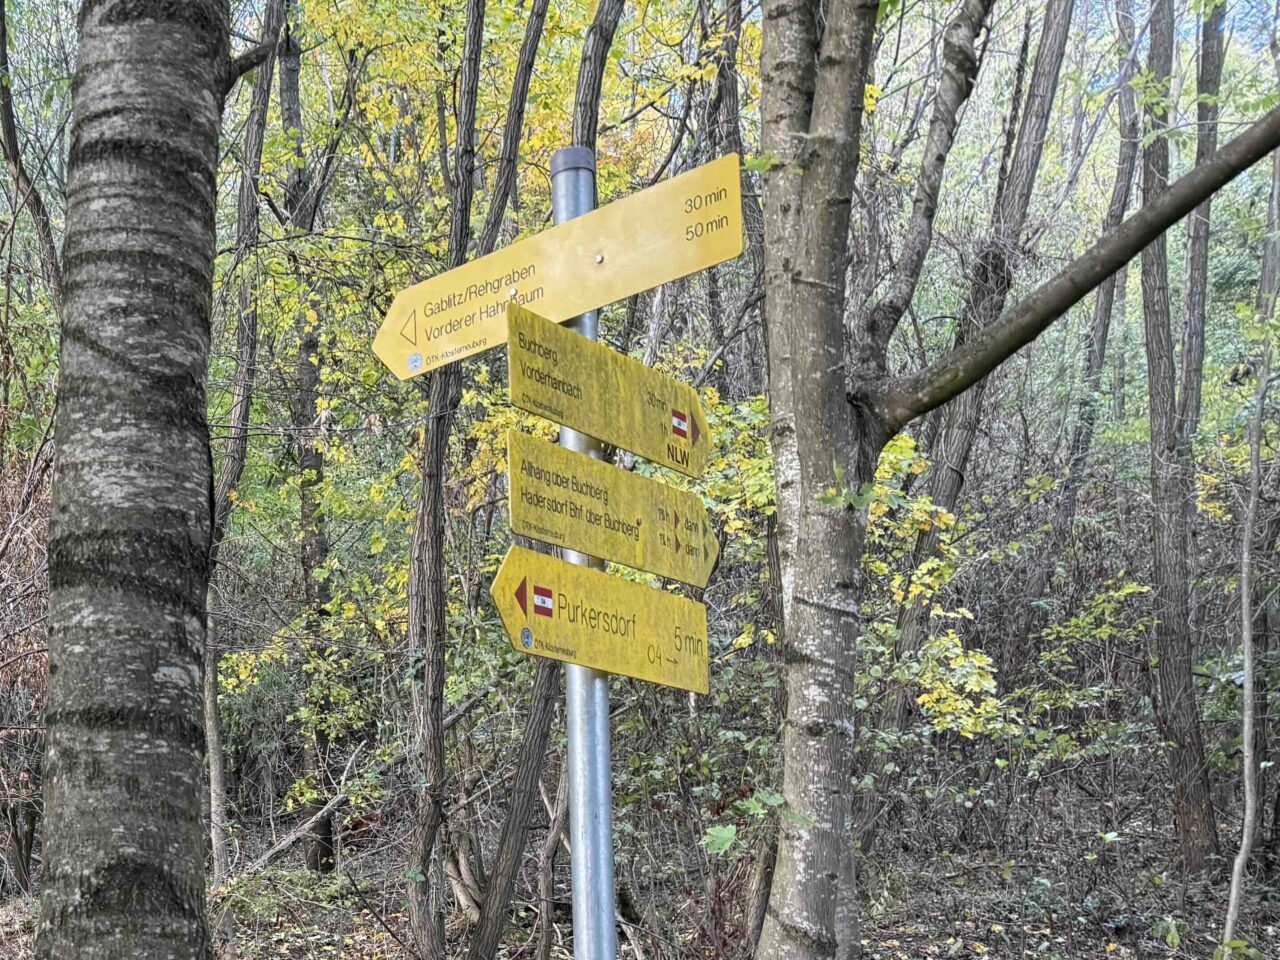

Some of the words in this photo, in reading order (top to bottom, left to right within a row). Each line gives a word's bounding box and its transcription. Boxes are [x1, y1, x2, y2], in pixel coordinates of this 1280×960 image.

[423, 264, 536, 318] Gablitz/Rehgraben
[684, 194, 703, 214] 30
[704, 186, 727, 207] min
[424, 311, 477, 342] Vorderer
[685, 222, 704, 242] 50
[706, 214, 729, 235] min
[518, 331, 558, 367] Buchberg
[519, 358, 583, 401] Vorderhainbach
[667, 443, 690, 468] NLW
[520, 486, 568, 516] Hadersdorf
[604, 512, 640, 542] Buchberg
[571, 475, 608, 506] Buchberg
[557, 592, 637, 641] Purkersdorf
[674, 625, 683, 652] 5
[684, 631, 704, 658] min
